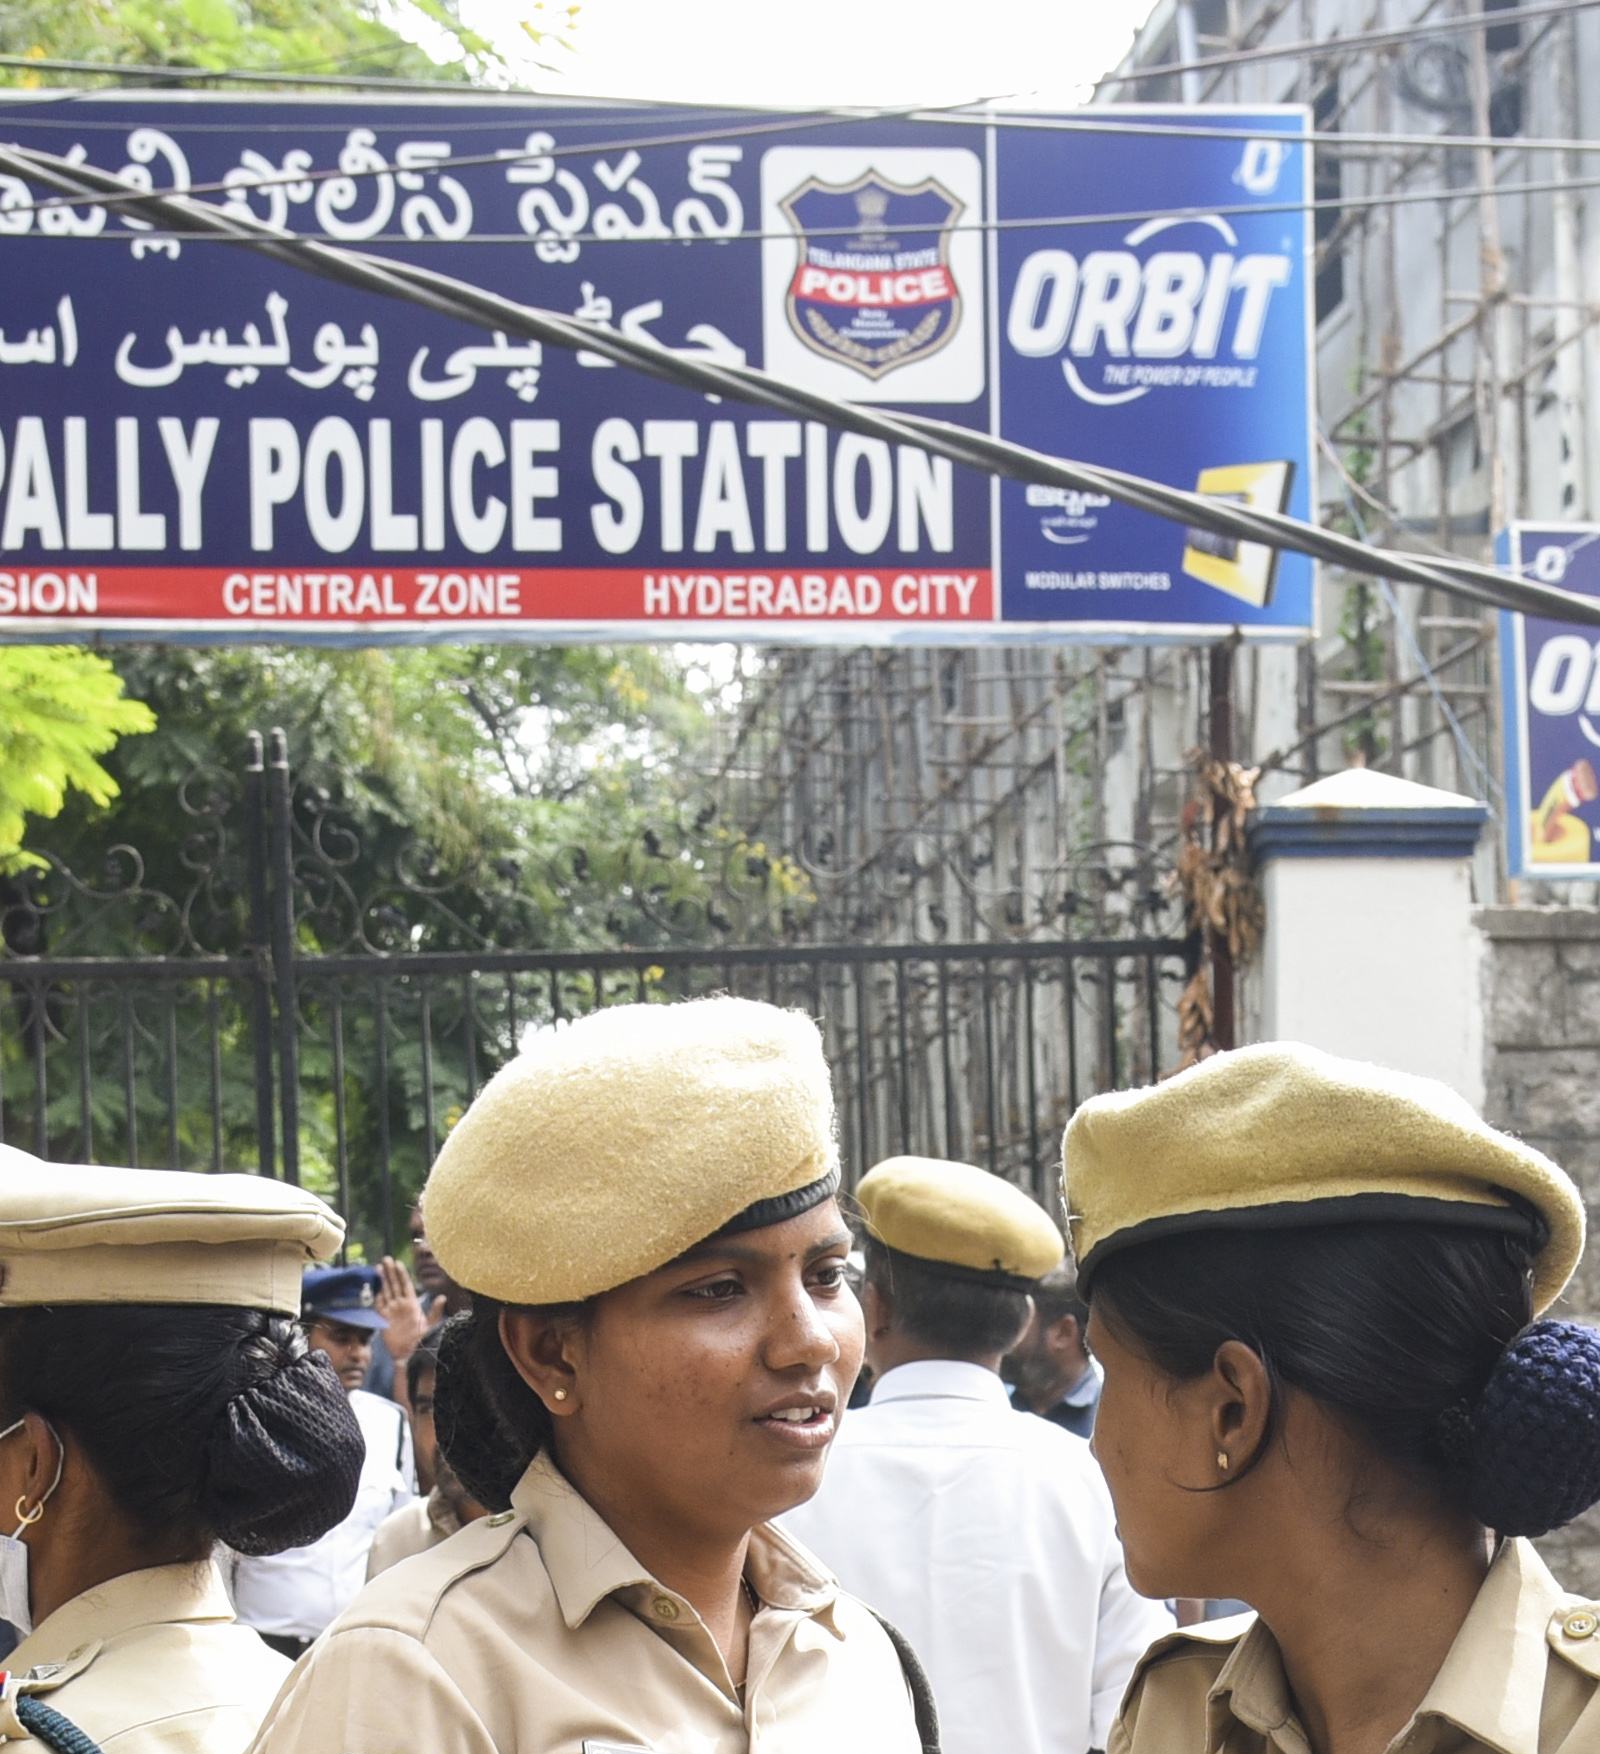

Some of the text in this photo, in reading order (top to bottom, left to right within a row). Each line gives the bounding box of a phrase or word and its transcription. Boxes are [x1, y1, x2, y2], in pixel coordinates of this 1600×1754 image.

[800, 268, 950, 305] POLICE
[1006, 248, 1291, 359] ORBIT
[114, 290, 380, 402] پولیس
[248, 415, 563, 554] POLICE
[590, 417, 954, 555] STATION
[222, 574, 407, 615] CENTRAL
[414, 574, 521, 615] ZONE
[643, 575, 883, 616] HYDERABAD
[891, 575, 979, 616] CITY
[1025, 571, 1097, 590] MODULAR
